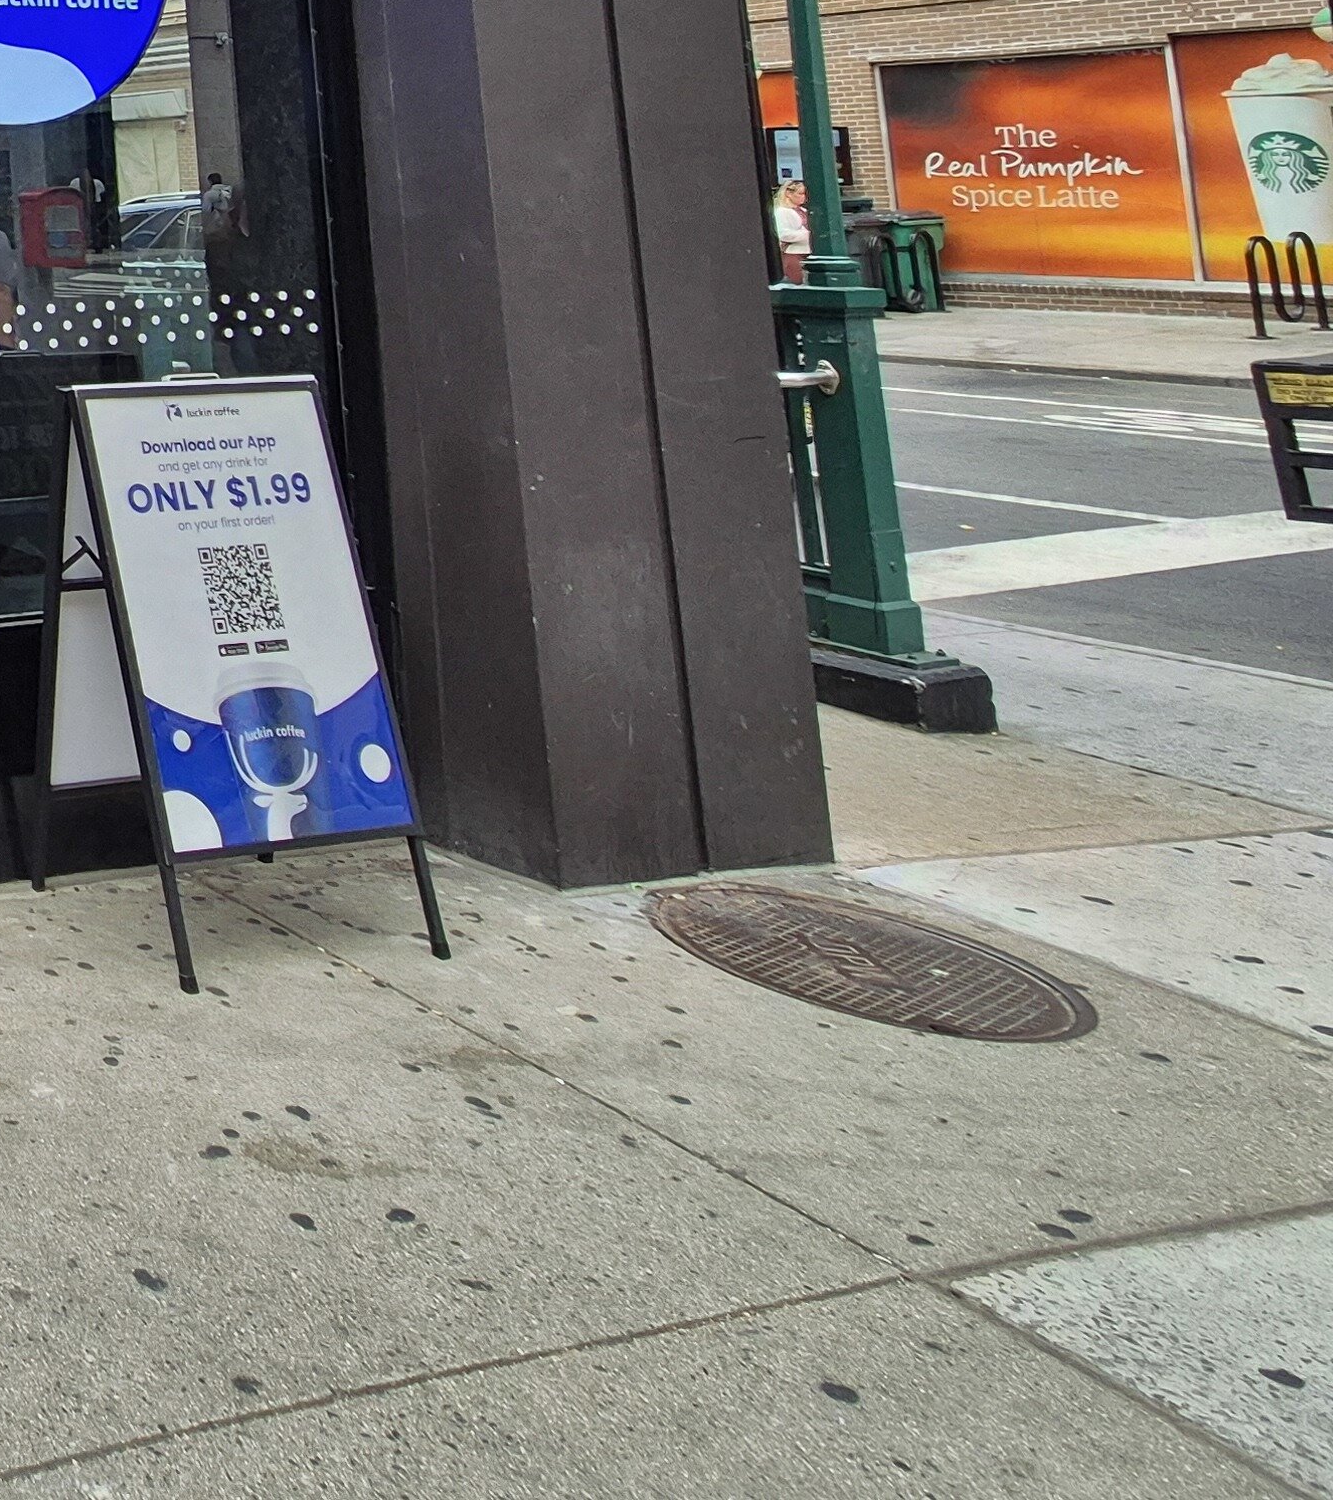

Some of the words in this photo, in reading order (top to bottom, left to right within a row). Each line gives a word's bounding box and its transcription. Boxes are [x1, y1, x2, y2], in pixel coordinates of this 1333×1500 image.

[994, 123, 1058, 149] The
[924, 152, 989, 179] Real
[991, 148, 1144, 186] Pumpkin
[951, 183, 1033, 213] Spice
[1036, 185, 1120, 209] Latte
[186, 407, 212, 418] luckin
[213, 407, 240, 417] coffee
[141, 436, 216, 454] Download
[219, 438, 243, 449] our
[247, 435, 276, 453] App
[158, 462, 179, 472] and
[182, 461, 201, 474] get
[202, 460, 223, 471] any
[225, 456, 251, 468] drink
[253, 455, 268, 467] for
[127, 479, 216, 514] ONLY
[226, 472, 311, 511] $1.99
[178, 521, 192, 532] on
[195, 519, 218, 533] your
[220, 516, 241, 528] first
[244, 514, 275, 526] order!
[244, 726, 273, 741] luckin
[275, 724, 306, 738] coffee
